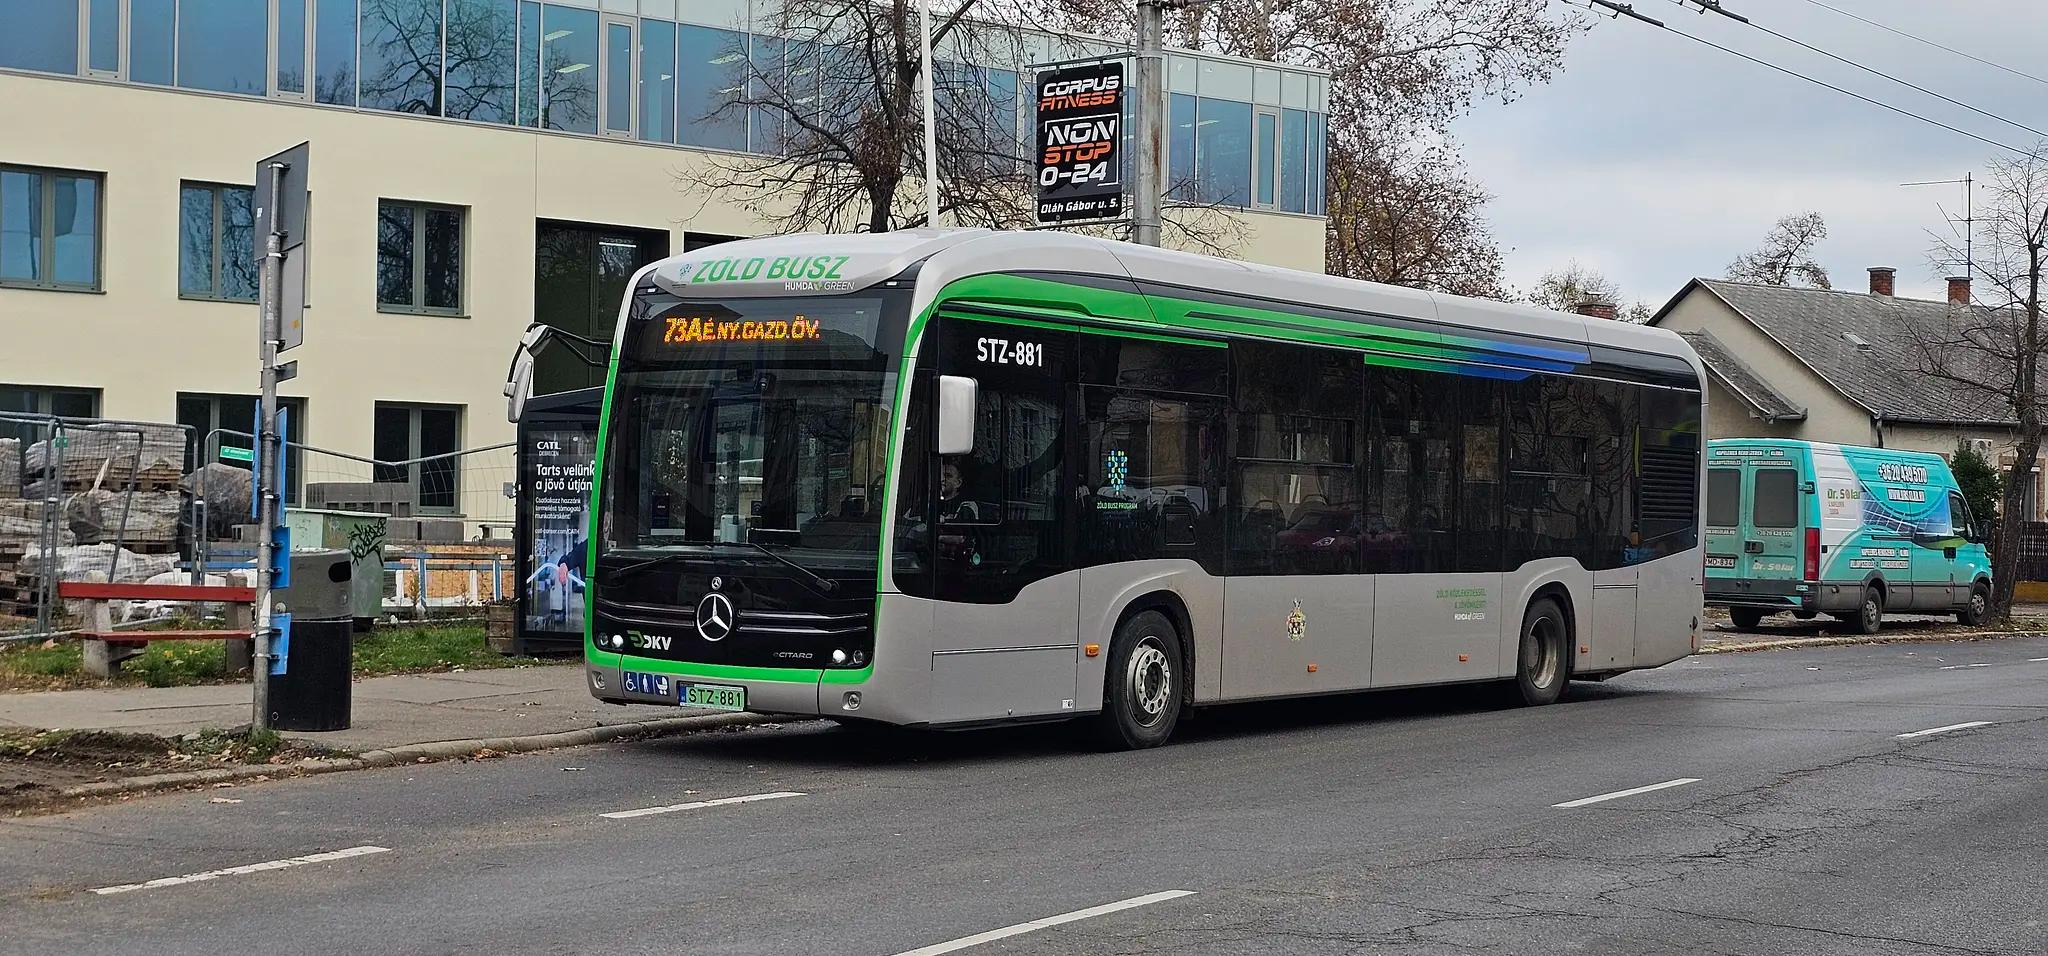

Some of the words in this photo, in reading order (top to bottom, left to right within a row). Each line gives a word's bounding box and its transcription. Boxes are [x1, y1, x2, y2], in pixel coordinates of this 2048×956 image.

[1043, 75, 1120, 97] CORPUS
[1040, 90, 1116, 112] FITNESS
[1047, 119, 1116, 146] NON
[1044, 141, 1112, 164] STOP
[1040, 161, 1108, 187] 0-24
[1040, 203, 1064, 214] Oláh
[1065, 200, 1096, 212] Gábor
[1097, 199, 1108, 209] u.
[766, 255, 849, 280] BUSZ
[784, 281, 814, 291] HUMDA
[824, 281, 855, 291] GREEN
[977, 337, 1043, 367] STZ-881
[536, 441, 561, 450] CATL
[536, 464, 561, 476] Tarts
[562, 463, 595, 476] velünk
[535, 480, 542, 490] a
[543, 478, 565, 493] jövő
[567, 478, 593, 493] útján
[1827, 489, 1838, 499] Dr.
[1840, 489, 1860, 500] Solar
[1752, 562, 1766, 571] Dr.
[1767, 563, 1794, 571] Solar
[643, 634, 672, 651] DKV
[688, 688, 742, 707] STZ-881
